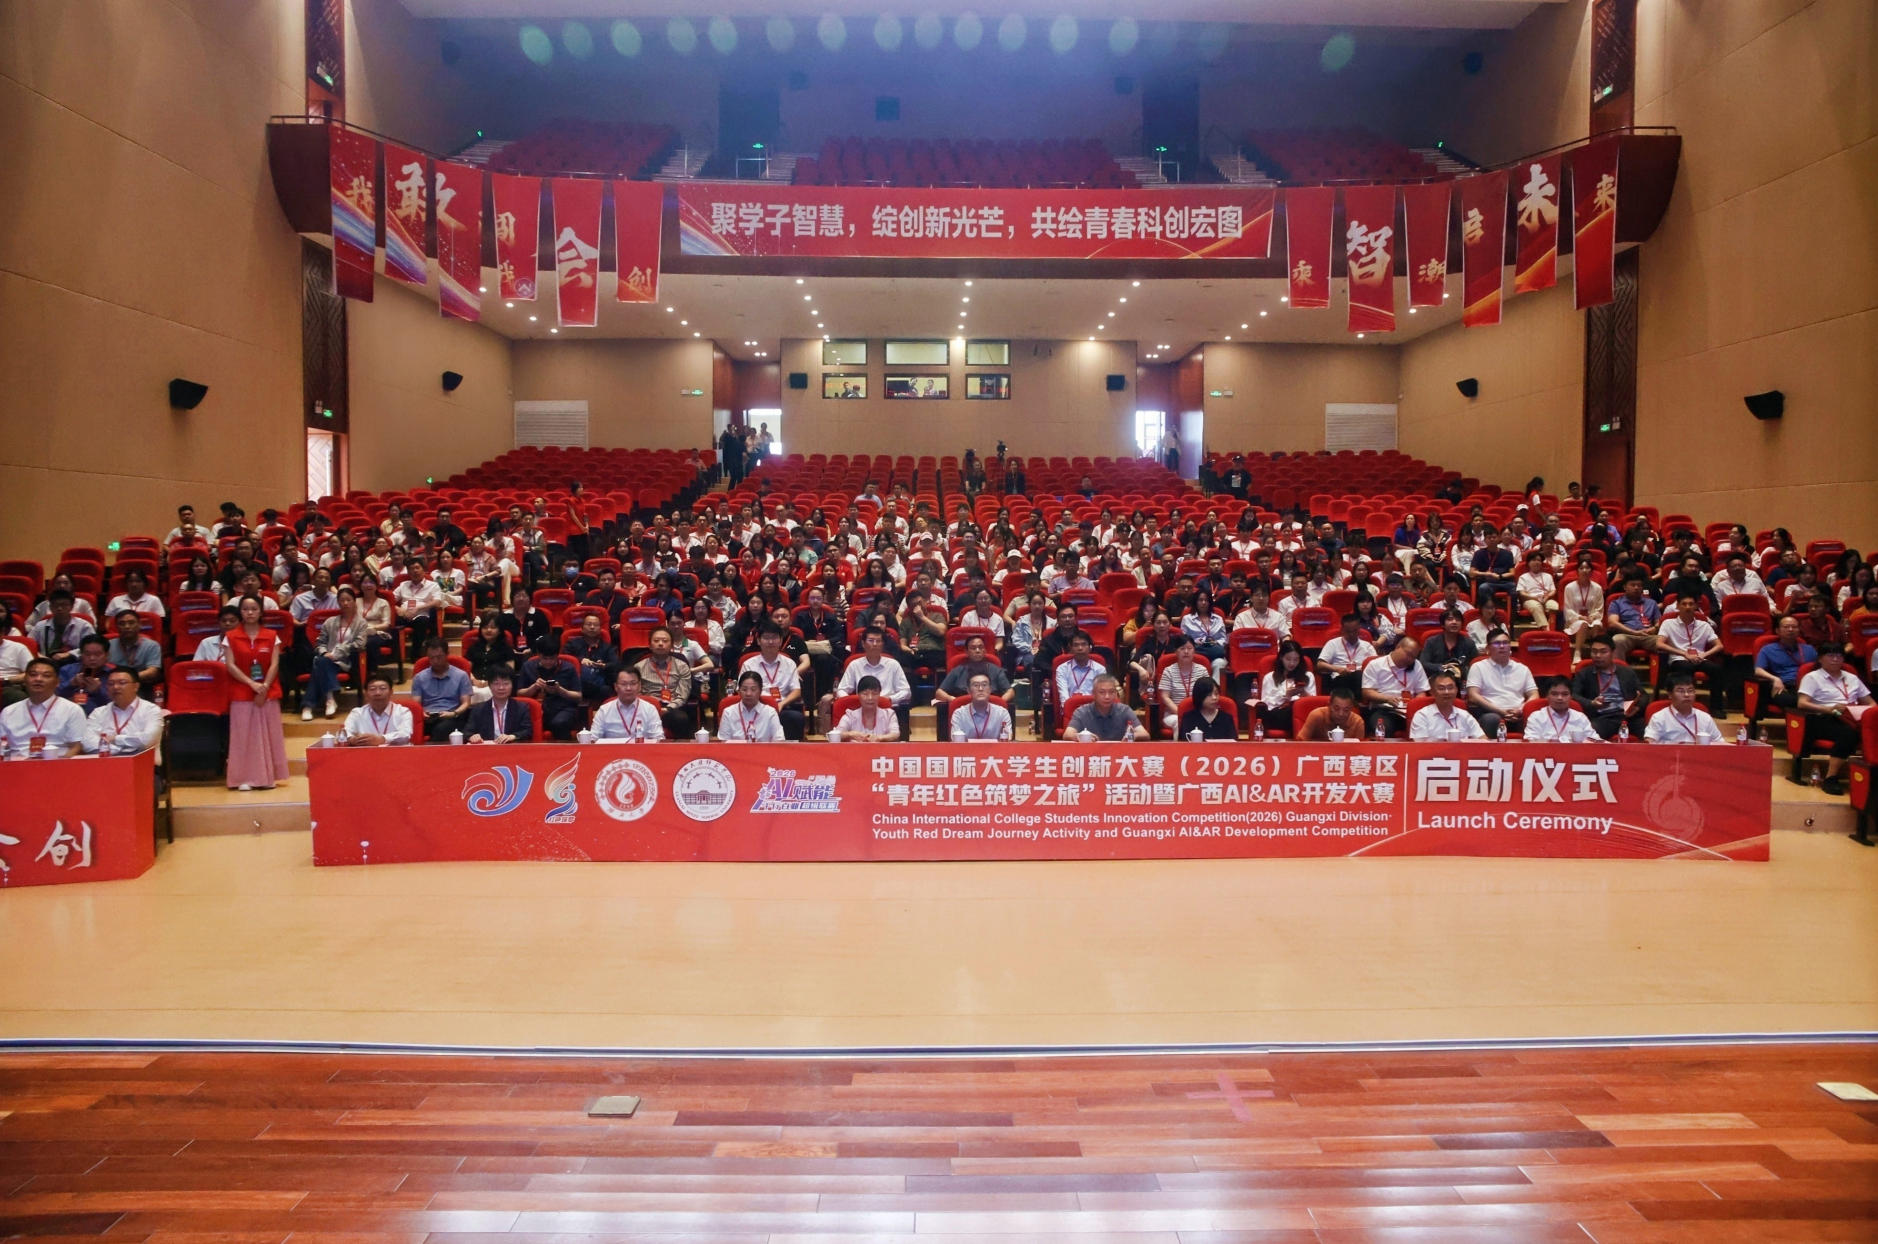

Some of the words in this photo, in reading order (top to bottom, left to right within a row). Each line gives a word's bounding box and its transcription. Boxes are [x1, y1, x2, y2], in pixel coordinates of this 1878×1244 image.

[711, 202, 1243, 239] 聚学子智慧，绽创新光芒，共绘青春科创宏图
[1414, 757, 1619, 803] 启动仪式
[872, 813, 909, 825] China
[912, 813, 991, 825] International
[993, 812, 1042, 828] College
[1044, 812, 1100, 824] Students
[1103, 812, 1168, 824] Innovation
[1171, 811, 1283, 826] Competition(2026)
[1285, 811, 1336, 825] Guangxi
[1418, 811, 1496, 829] Launch
[1503, 810, 1613, 835] Ceremony
[872, 828, 910, 840] Youth
[913, 827, 939, 840] Red
[942, 827, 984, 839] Dream
[987, 826, 1040, 841] Journey
[1042, 826, 1091, 841] Activity
[1094, 826, 1118, 838] and
[1121, 826, 1176, 840] Guangxi
[1178, 826, 1221, 838] AI&AR
[1224, 825, 1308, 840] Development
[1311, 824, 1389, 838] Competition
